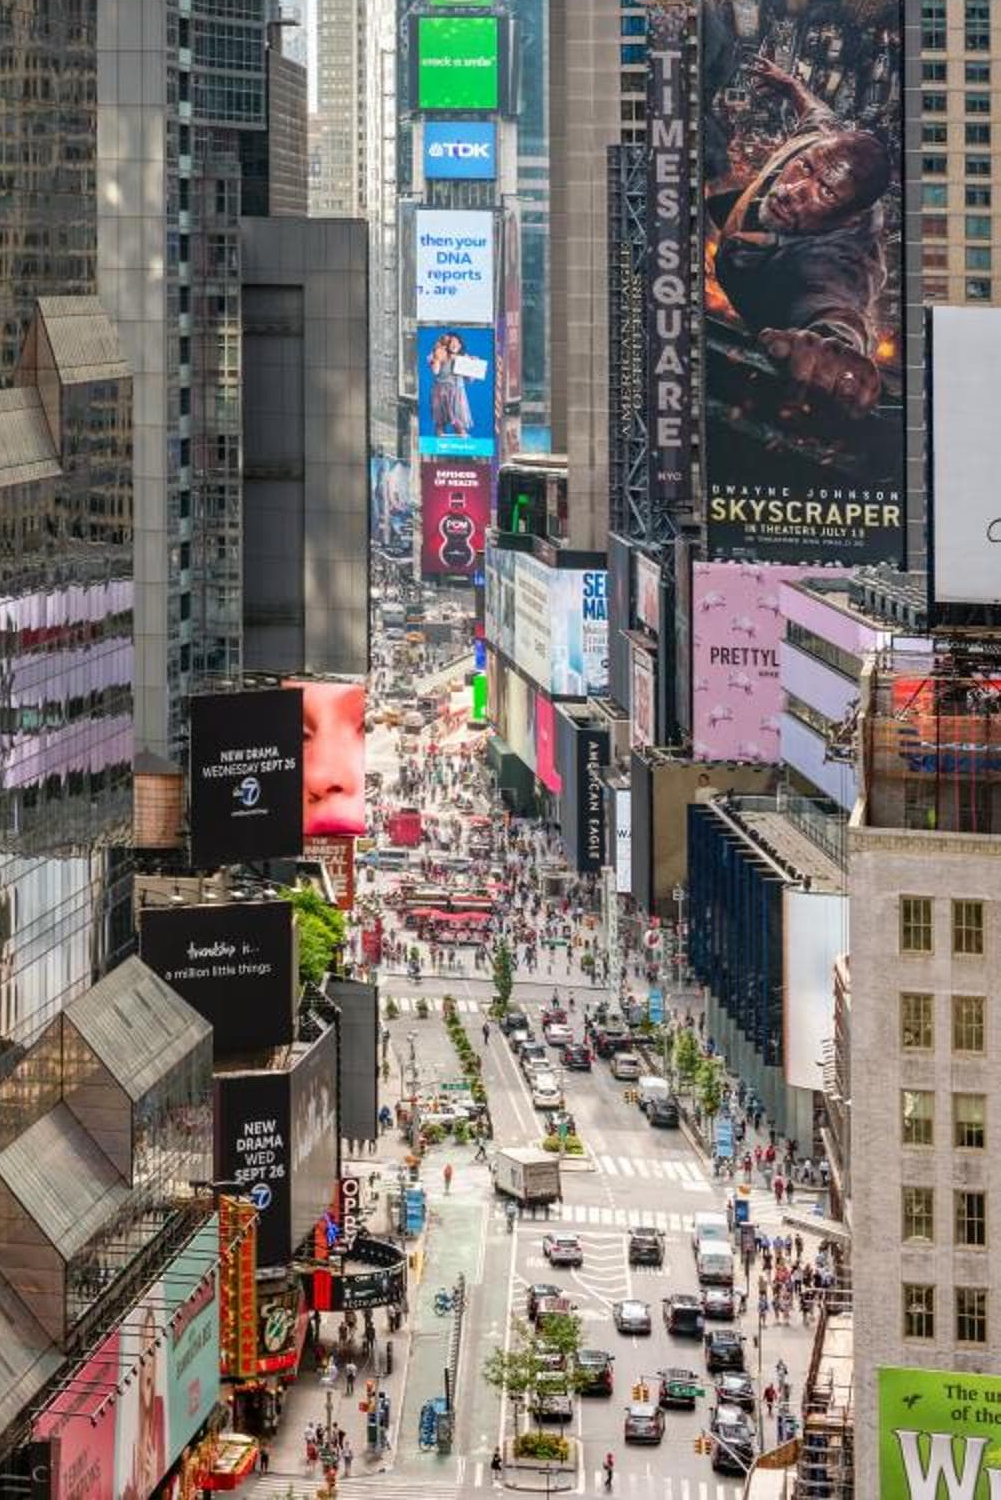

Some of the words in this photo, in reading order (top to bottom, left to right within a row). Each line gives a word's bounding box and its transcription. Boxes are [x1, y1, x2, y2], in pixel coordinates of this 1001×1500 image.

[651, 51, 683, 219] TIMES
[443, 143, 489, 157] TDK
[420, 233, 453, 247] then
[455, 237, 487, 249] your
[437, 252, 472, 264] DNA
[427, 270, 482, 283] reports
[620, 241, 632, 312] EAGLE
[652, 239, 686, 447] SQUARE
[620, 317, 632, 438] AMERICAN
[658, 471, 683, 481] NYC
[711, 484, 790, 497] DWAYNE
[806, 487, 899, 501] JOHNSON
[711, 497, 900, 527] SKYSCRAPER
[760, 524, 816, 537] THEATERS
[820, 527, 847, 538] JULY
[710, 646, 780, 667] PRETTYL
[220, 749, 244, 763] NEW
[246, 746, 279, 760] DRAMA
[202, 761, 259, 778] WEDNESDAY
[260, 759, 283, 773] SEPT
[588, 818, 600, 860] EAGLE
[165, 971, 172, 981] a
[174, 966, 210, 979] million
[212, 964, 236, 977] little
[238, 962, 272, 975] things
[244, 1119, 277, 1137] NEW
[236, 1134, 284, 1152] DRAMA
[244, 1150, 276, 1166] WED
[234, 1166, 267, 1181] SEPT
[269, 1163, 286, 1179] 26
[944, 1382, 979, 1401] The
[950, 1406, 972, 1421] of
